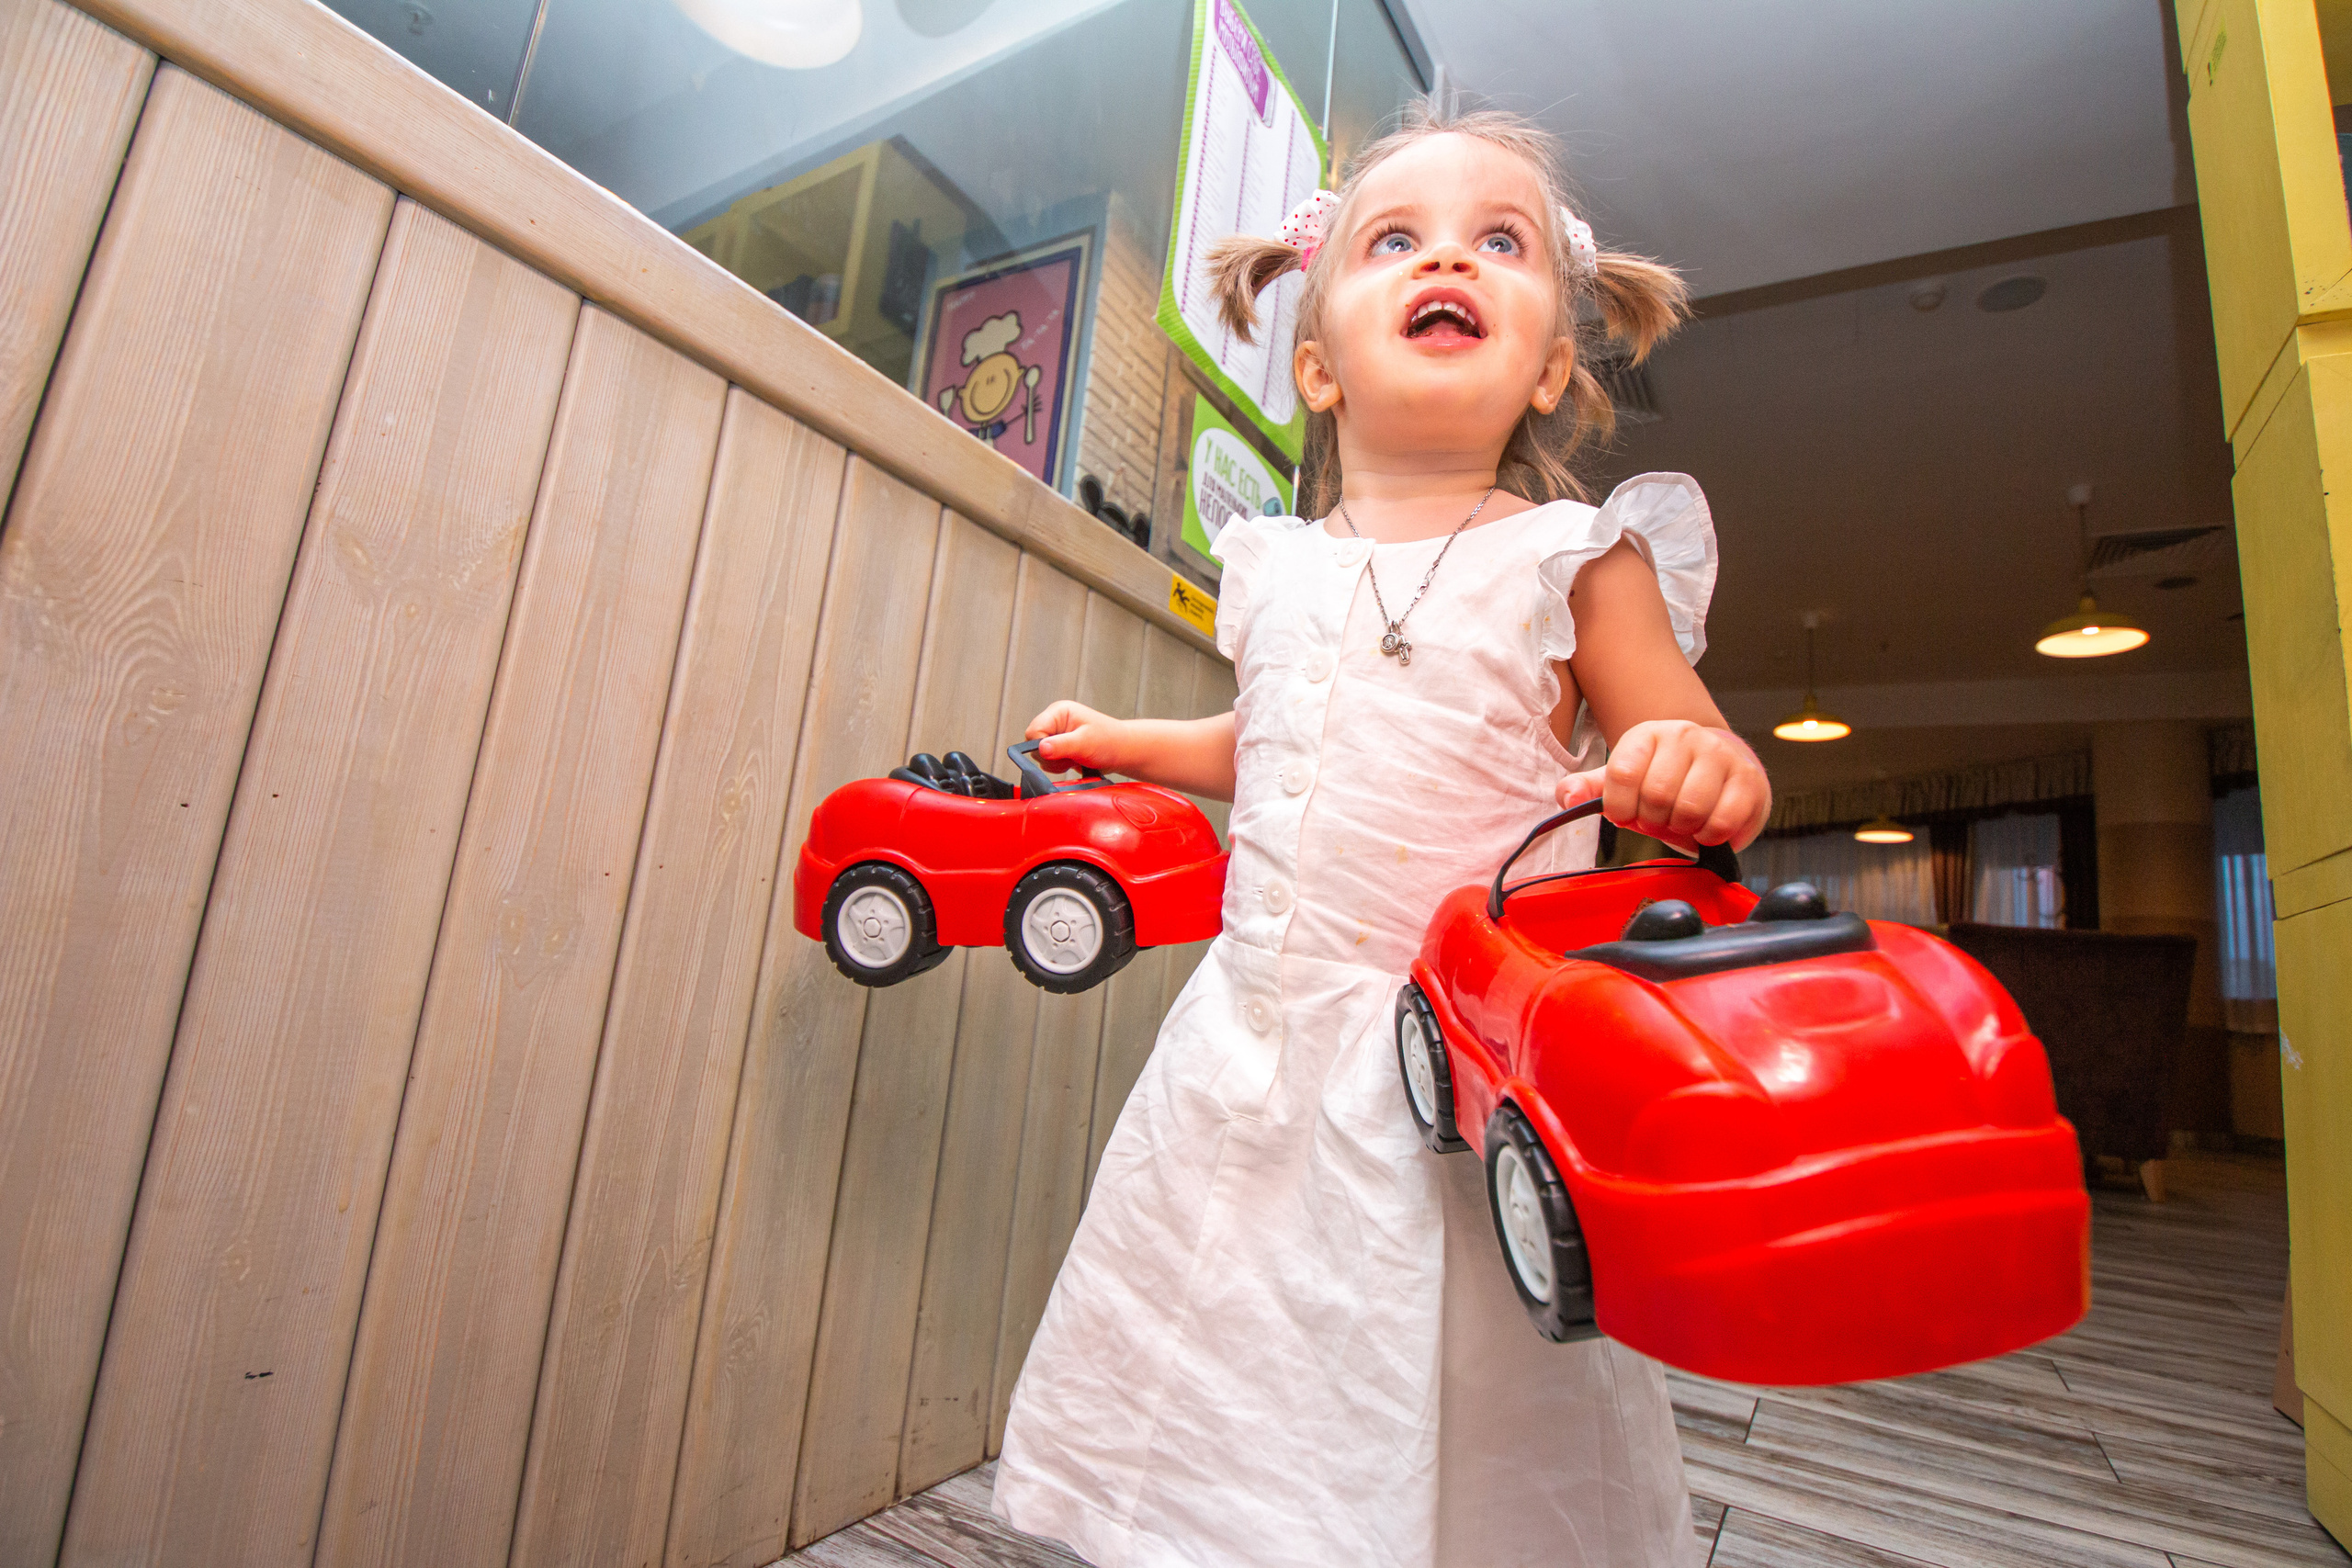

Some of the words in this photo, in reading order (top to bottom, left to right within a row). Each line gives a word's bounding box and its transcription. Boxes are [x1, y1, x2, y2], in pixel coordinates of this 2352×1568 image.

[1204, 435, 1213, 463] У
[1214, 445, 1237, 487] НАС
[1238, 467, 1261, 510] ЕСТЬ
